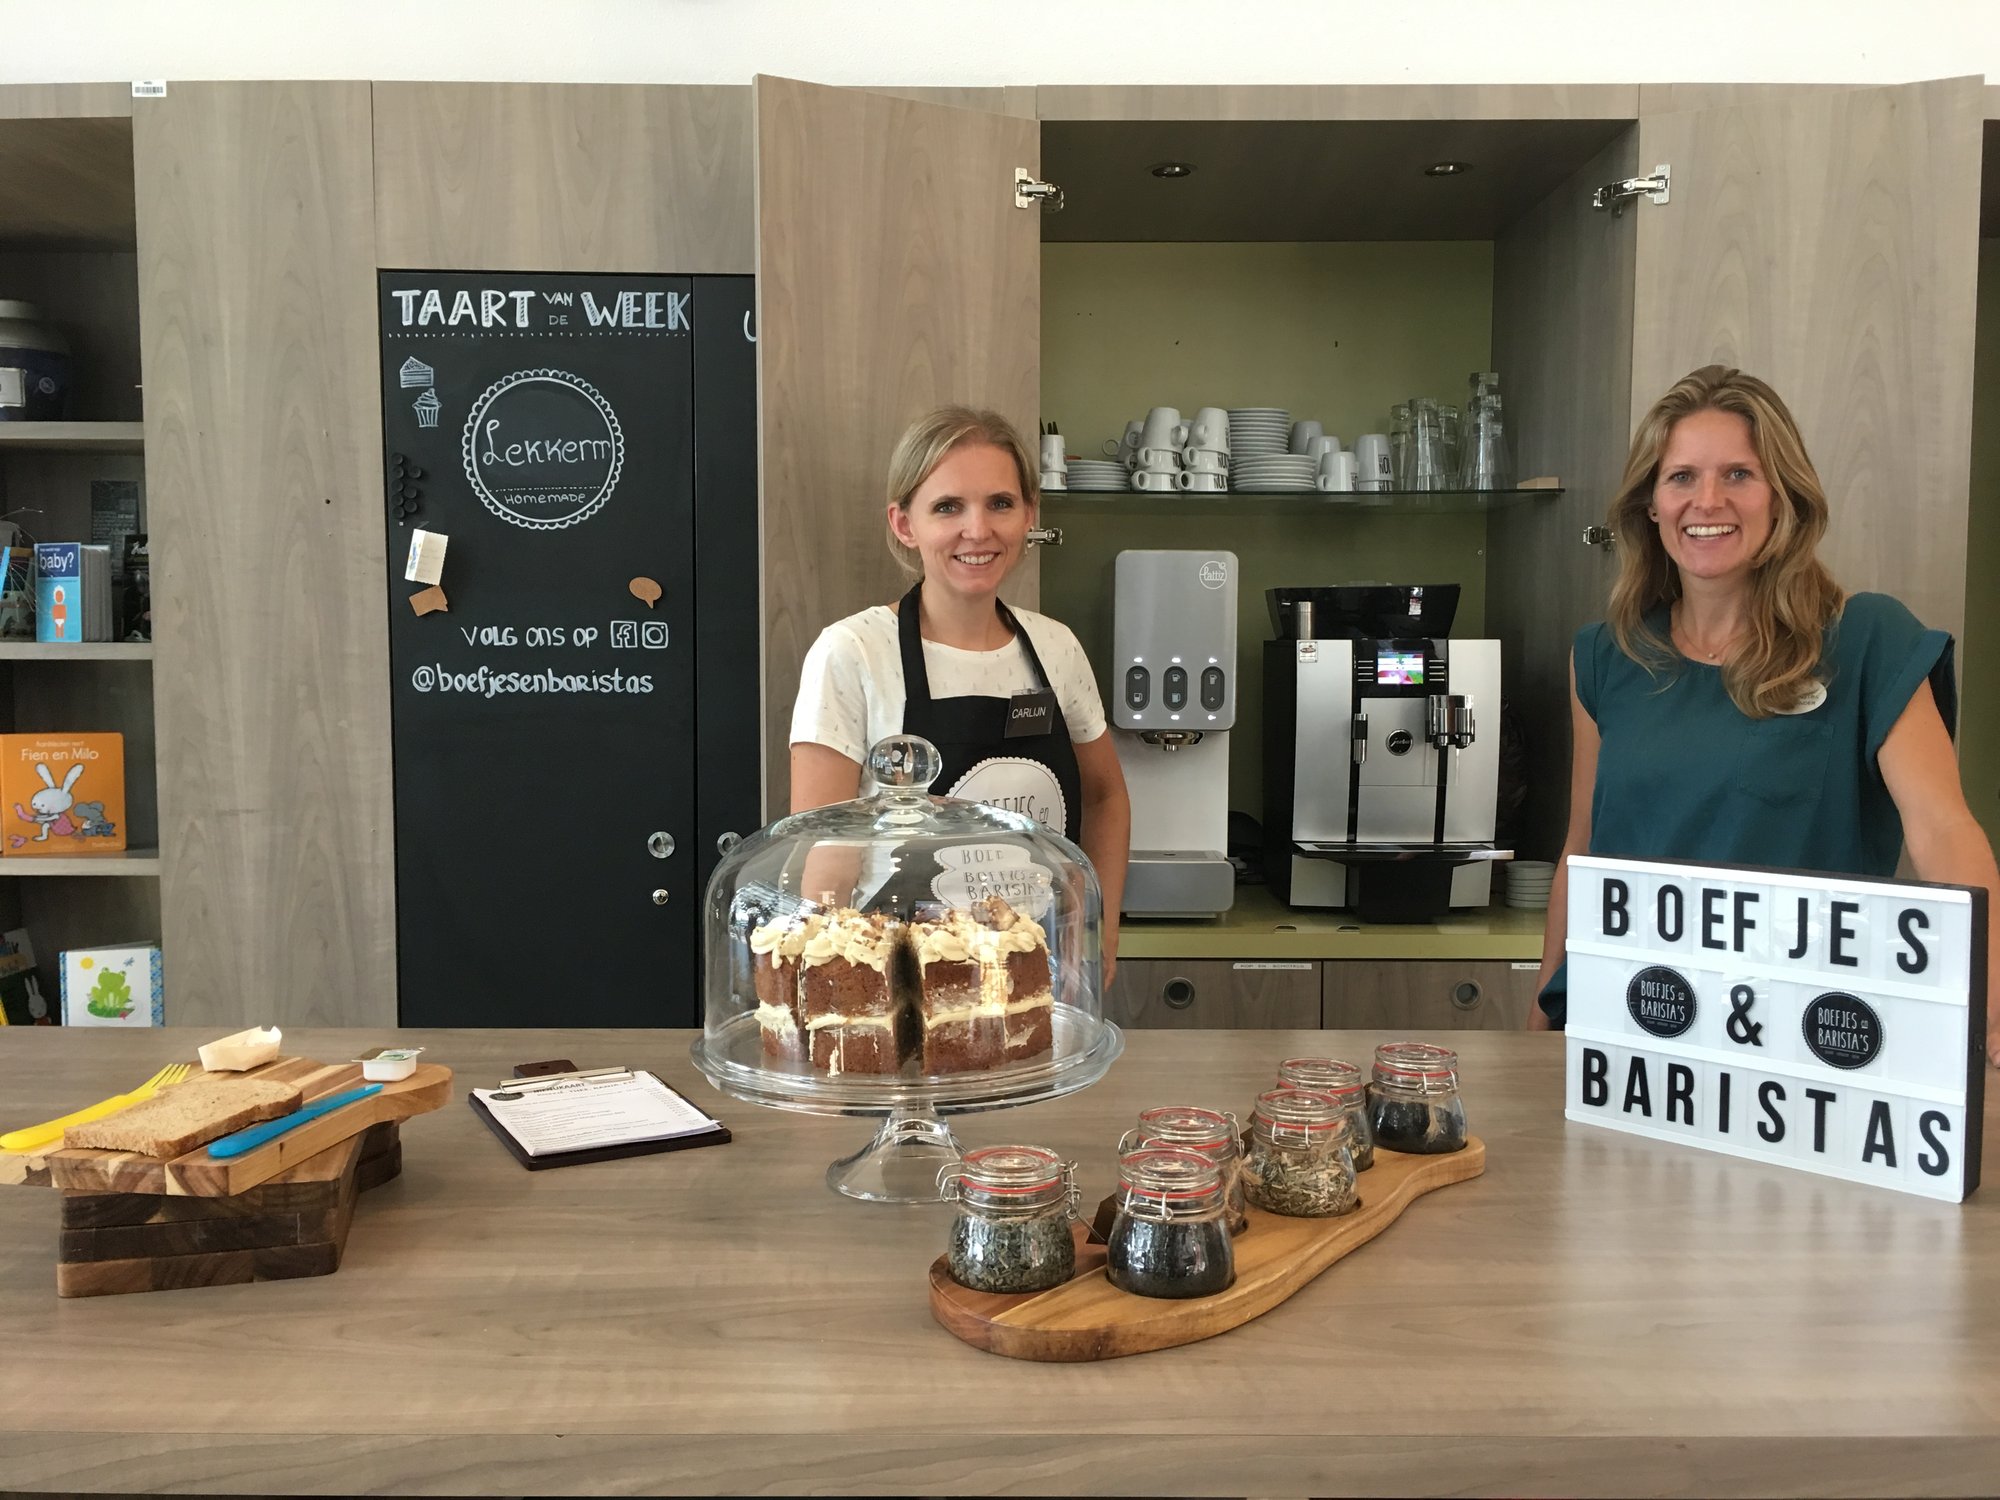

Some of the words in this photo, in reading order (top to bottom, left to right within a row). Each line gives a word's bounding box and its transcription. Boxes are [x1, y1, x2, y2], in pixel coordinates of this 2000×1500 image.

[392, 290, 535, 328] TAART
[542, 292, 573, 306] VAN
[580, 291, 691, 330] WEEK
[549, 315, 569, 325] DE
[40, 552, 74, 572] baby?
[412, 663, 655, 699] @boefjesenbaristas
[1011, 706, 1047, 719] CARLIJN
[21, 748, 49, 760] Fien
[52, 751, 69, 760] en
[72, 747, 99, 760] Milo
[1602, 877, 1930, 974] BOEFJES
[1641, 980, 1676, 1000] BOEFJES
[1641, 999, 1685, 1022] BARISTA'S
[1726, 984, 1764, 1046] &
[1817, 1007, 1858, 1029] BOEFJES
[1818, 1028, 1869, 1052] BARISTA'S
[1581, 1047, 1951, 1176] BARISTAS
